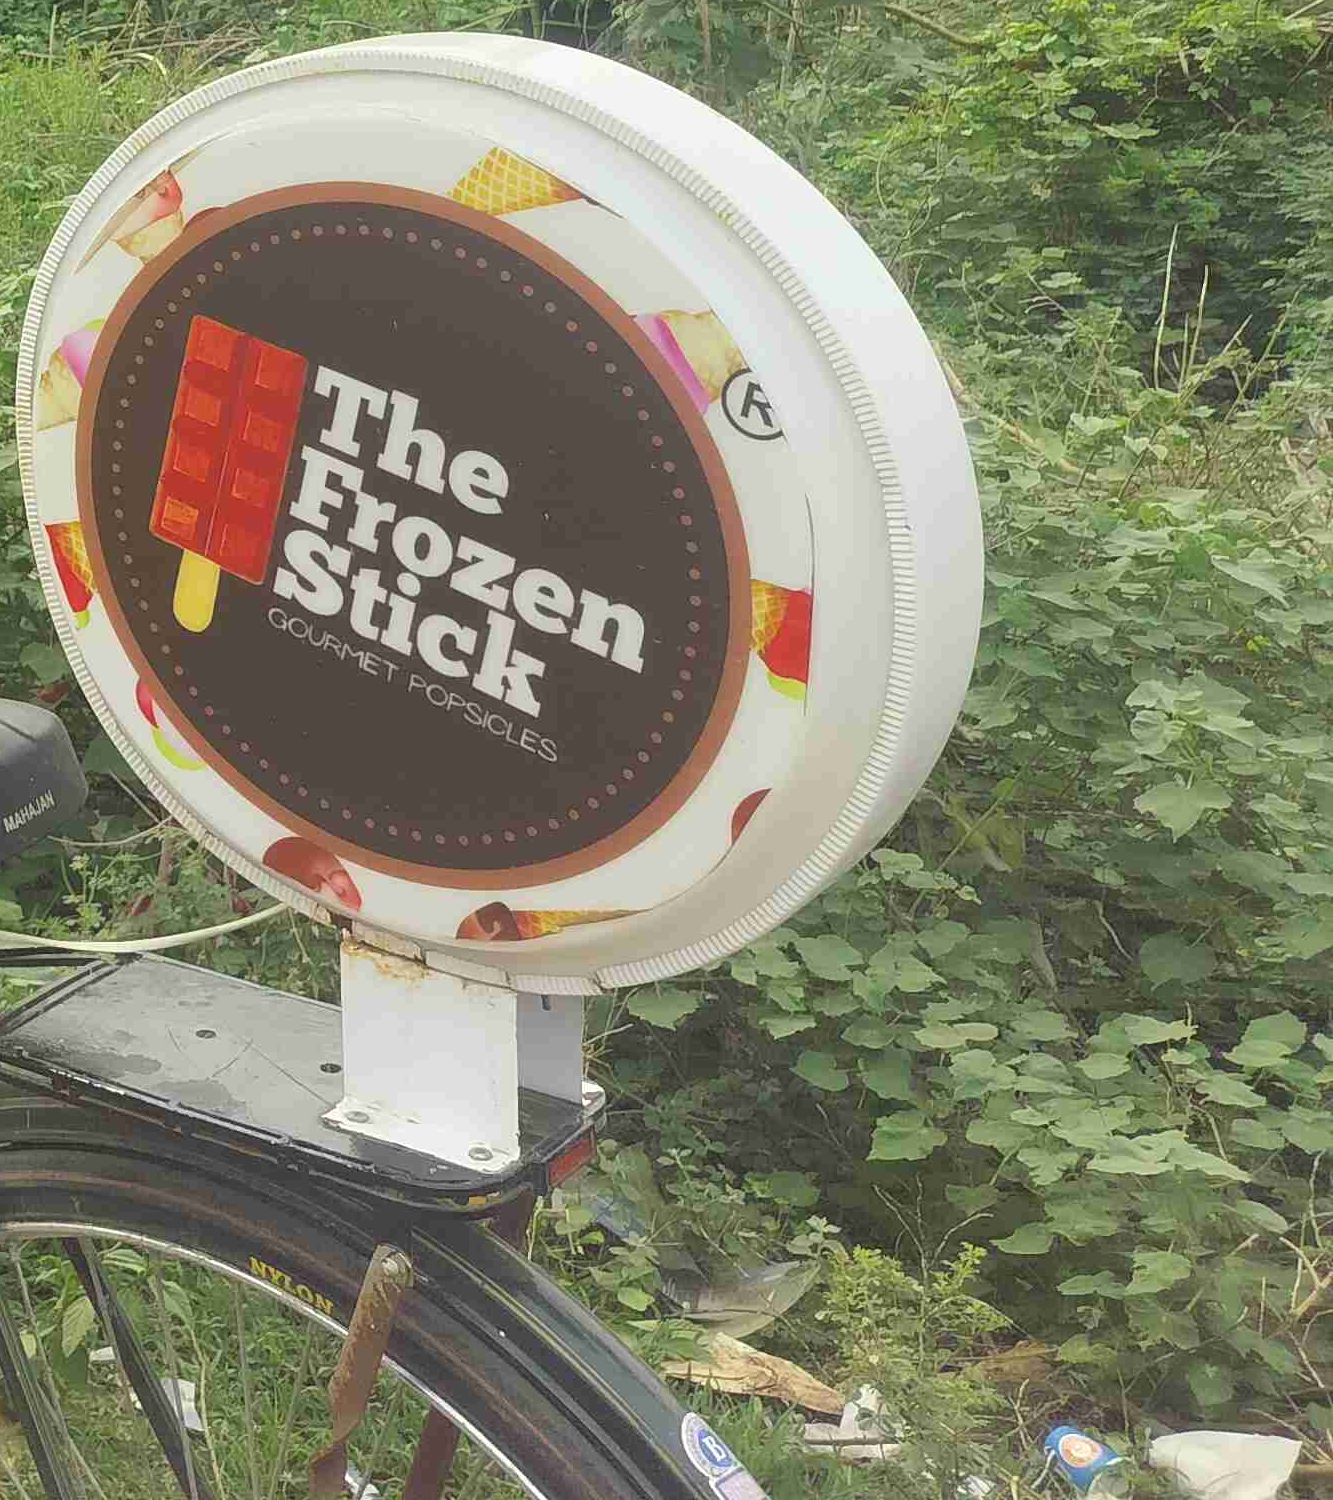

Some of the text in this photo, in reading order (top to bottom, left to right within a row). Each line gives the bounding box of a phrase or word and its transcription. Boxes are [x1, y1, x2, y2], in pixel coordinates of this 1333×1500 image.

[314, 365, 509, 514] The
[273, 529, 545, 718] Stick
[290, 445, 644, 674] Frozen
[268, 607, 558, 762] GOURMET POPSICLES
[2, 789, 55, 833] MAHAJAN
[249, 1256, 334, 1316] NYLON
